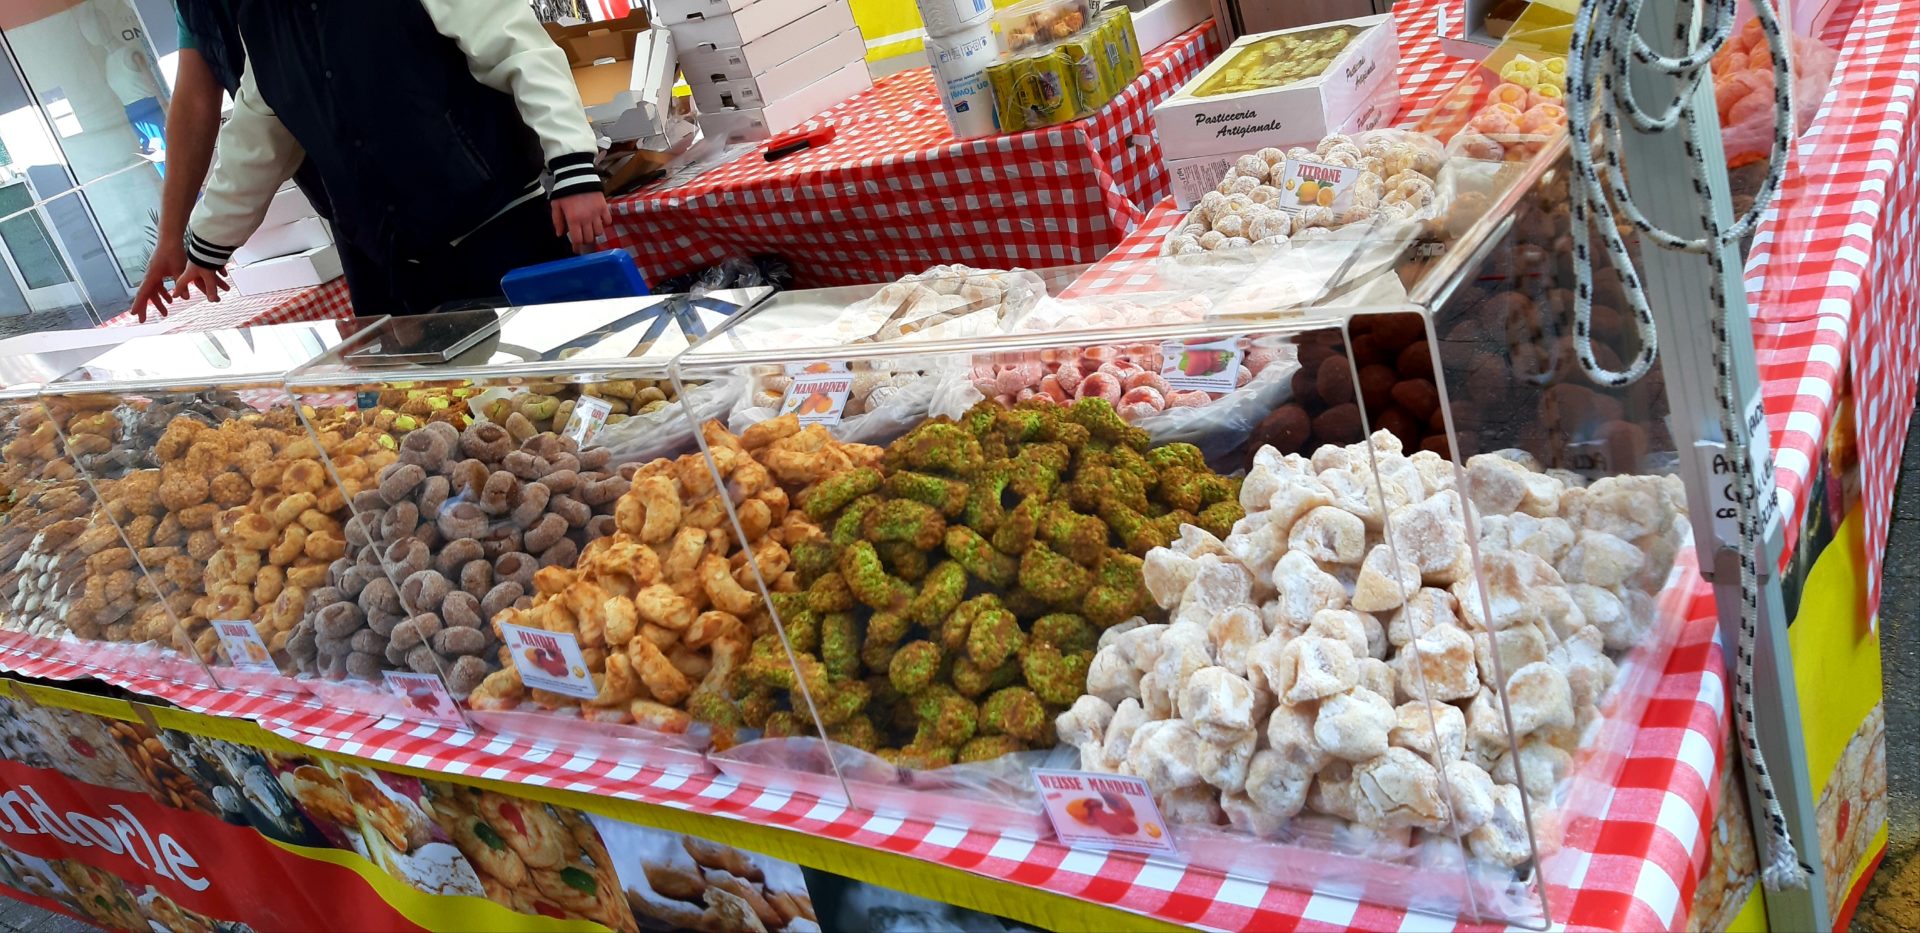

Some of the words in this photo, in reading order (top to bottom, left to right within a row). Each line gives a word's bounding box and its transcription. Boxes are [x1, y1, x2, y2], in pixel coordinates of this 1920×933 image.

[1195, 110, 1257, 126] Pasticceria
[1216, 120, 1281, 138] Artigianale
[1297, 164, 1342, 183] ZITRONE
[793, 381, 848, 395] MANDARINEN
[1038, 775, 1084, 791] WEISSE
[1087, 777, 1146, 797] MANDELN
